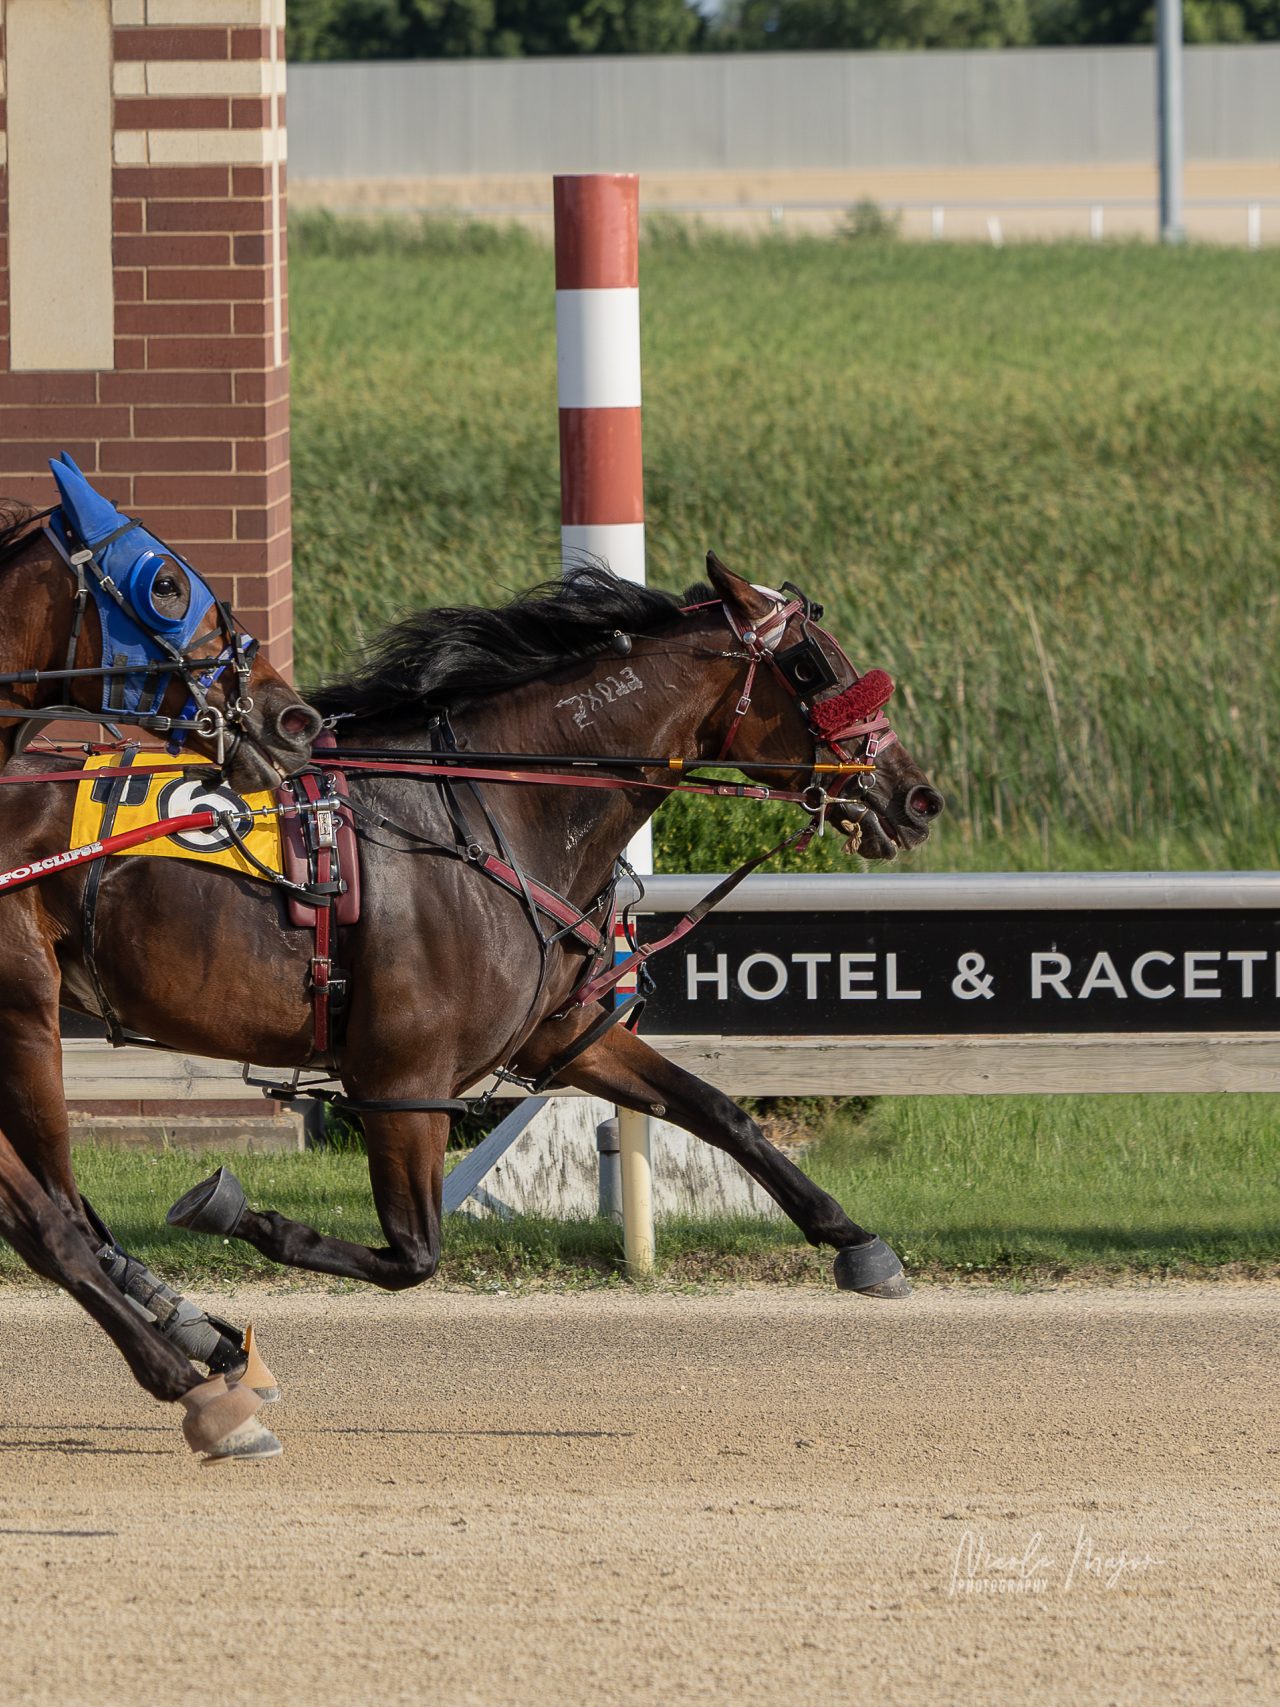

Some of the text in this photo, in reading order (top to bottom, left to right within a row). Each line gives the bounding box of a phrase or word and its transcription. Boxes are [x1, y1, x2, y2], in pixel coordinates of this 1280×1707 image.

[166, 778, 243, 847] 6
[686, 950, 1280, 1001] HOTEL & RACET
